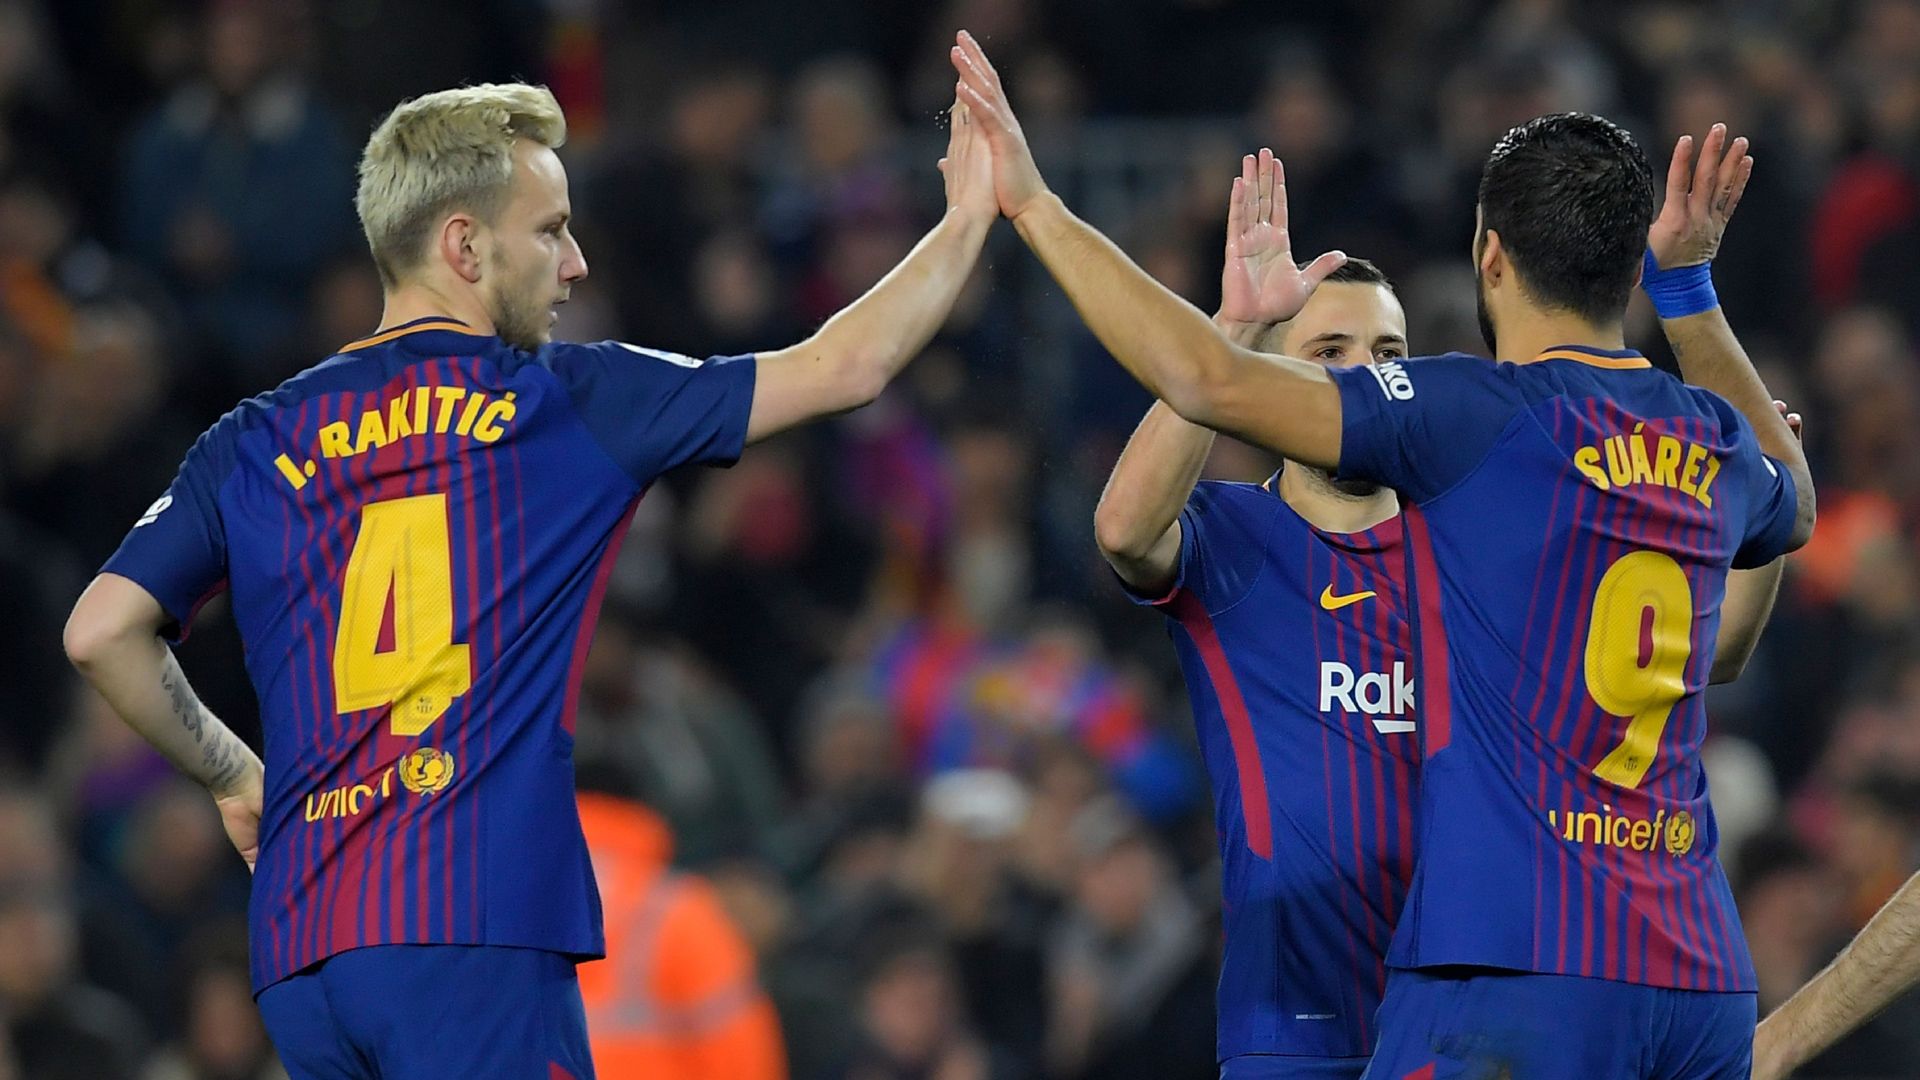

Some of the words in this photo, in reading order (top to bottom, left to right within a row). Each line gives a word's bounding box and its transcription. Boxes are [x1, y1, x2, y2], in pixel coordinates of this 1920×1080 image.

[1378, 361, 1415, 400] KO
[274, 453, 317, 491] I.
[319, 386, 516, 458] RAKITIĆ
[1574, 422, 1721, 509] SUÁREZ
[333, 493, 471, 736] 4
[1585, 550, 1692, 789] 9
[305, 767, 394, 822] unicf
[1549, 804, 1665, 851] unicef
